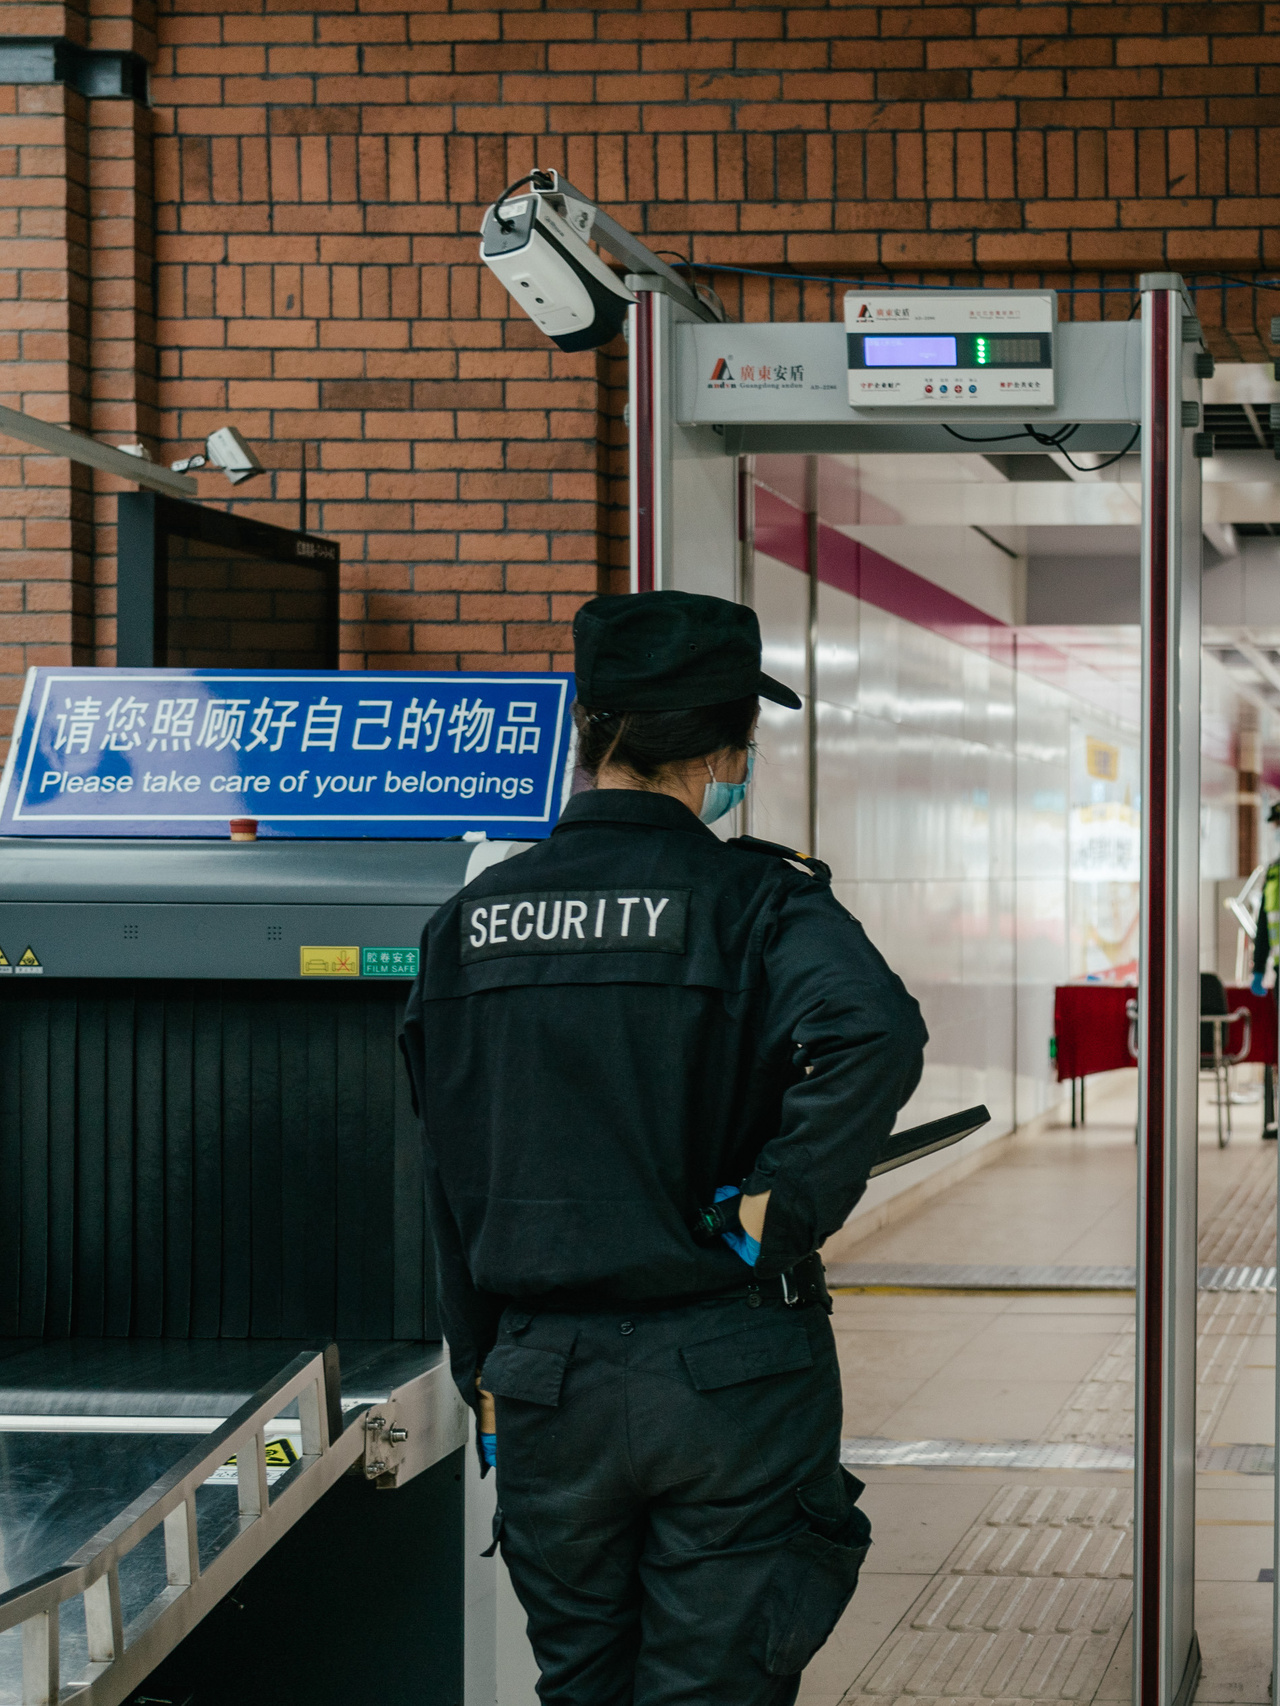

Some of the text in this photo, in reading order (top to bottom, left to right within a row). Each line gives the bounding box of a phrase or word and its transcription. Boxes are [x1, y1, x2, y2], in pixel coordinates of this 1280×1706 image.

[740, 382, 780, 390] Guangdong
[53, 695, 542, 755] 请您照顾好自己的物品
[40, 769, 535, 799] Please take care of your belongings
[469, 896, 670, 948] SECURITY
[366, 952, 416, 963] 胶卷安全
[366, 965, 416, 973] FILM SAFE
